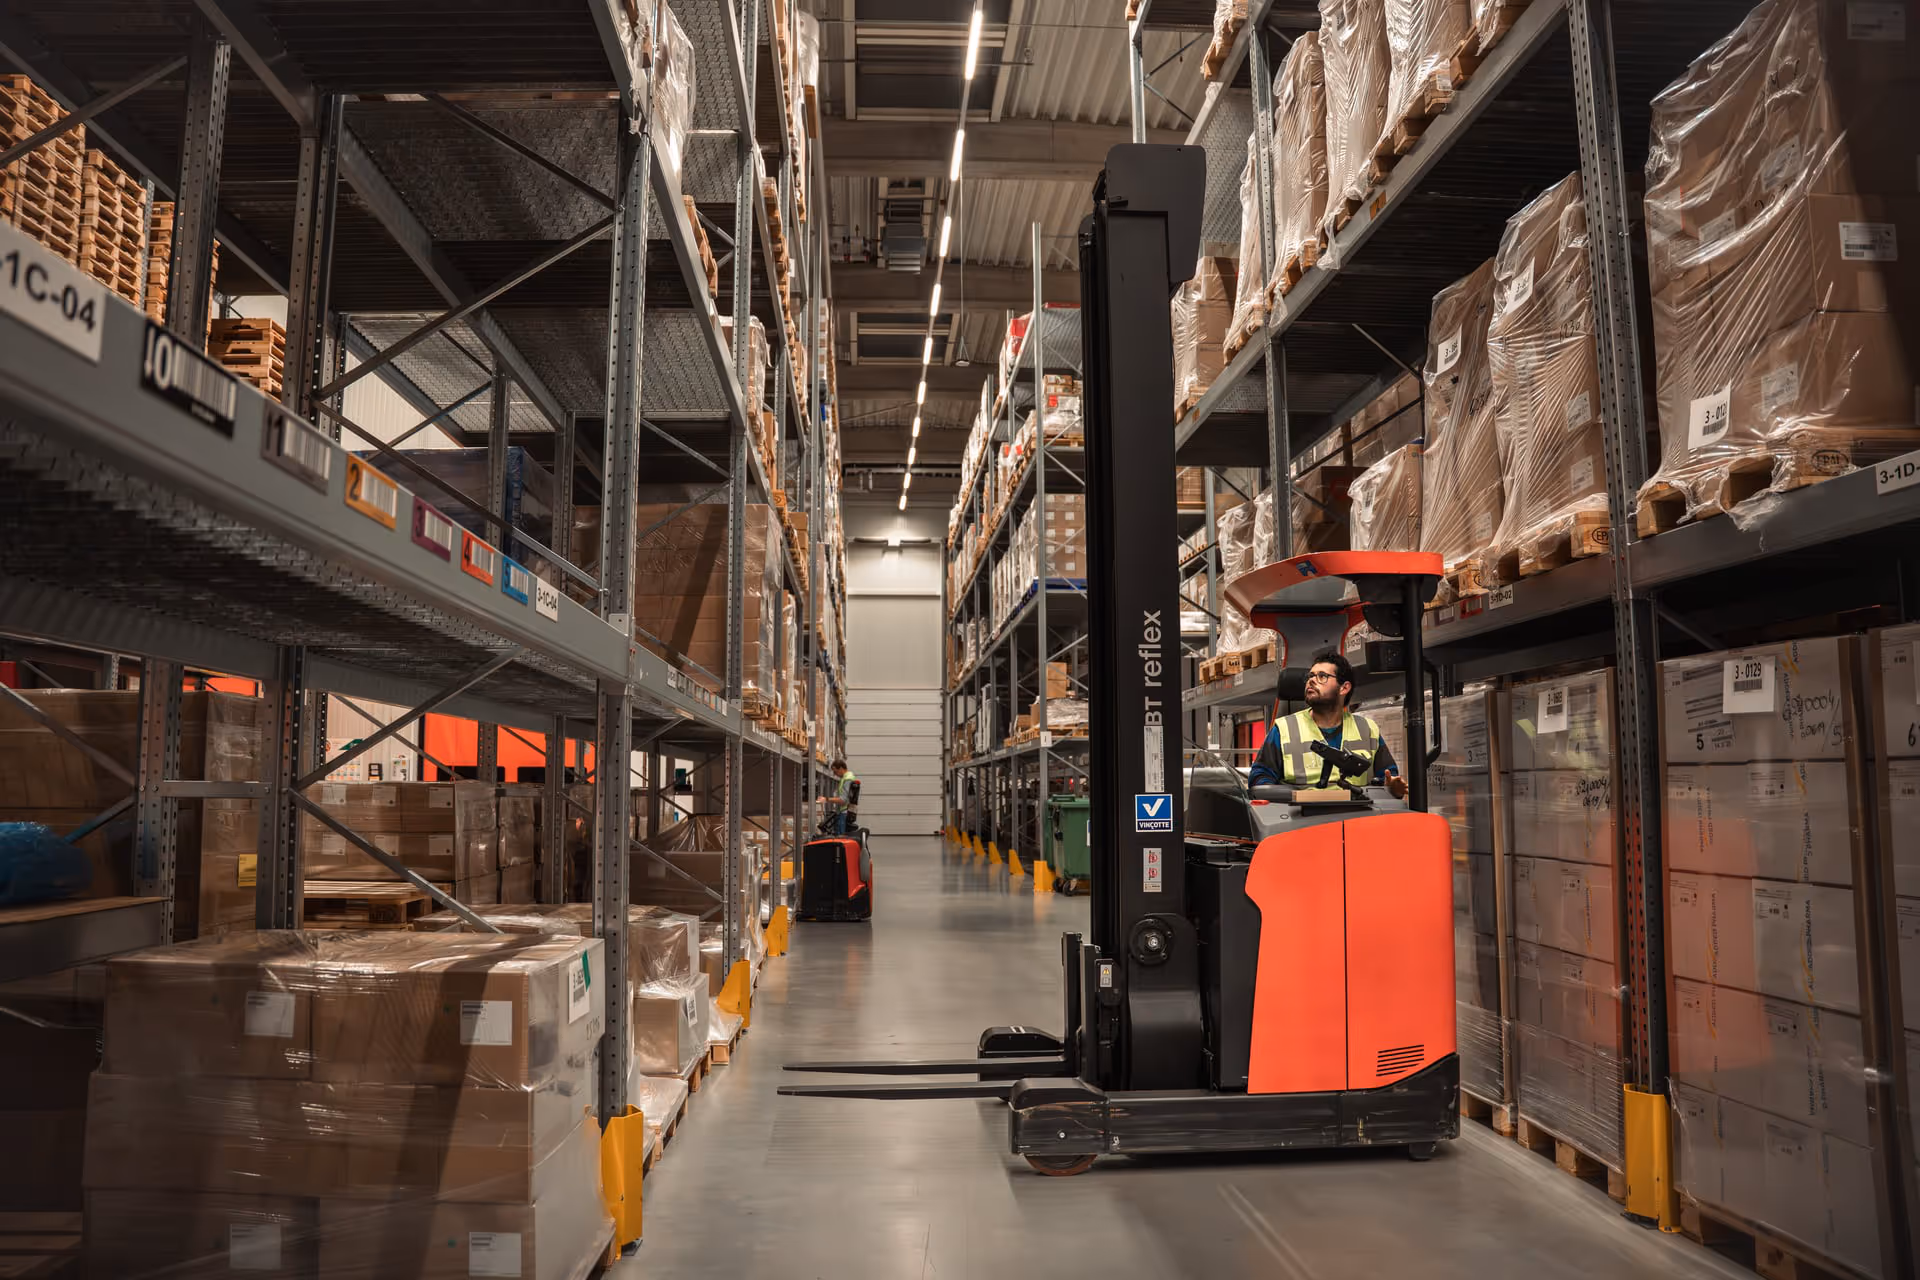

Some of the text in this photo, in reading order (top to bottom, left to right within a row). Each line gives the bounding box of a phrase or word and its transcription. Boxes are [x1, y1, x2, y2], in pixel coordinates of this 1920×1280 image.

[350, 462, 360, 501] 2
[415, 505, 424, 538] 3
[464, 537, 471, 564] 4
[504, 562, 511, 588] 5
[537, 588, 558, 611] 3-1C-04
[1138, 610, 1163, 726] BT reflex
[1696, 733, 1705, 750] 5
[1139, 821, 1170, 830] VINÇOTTE
